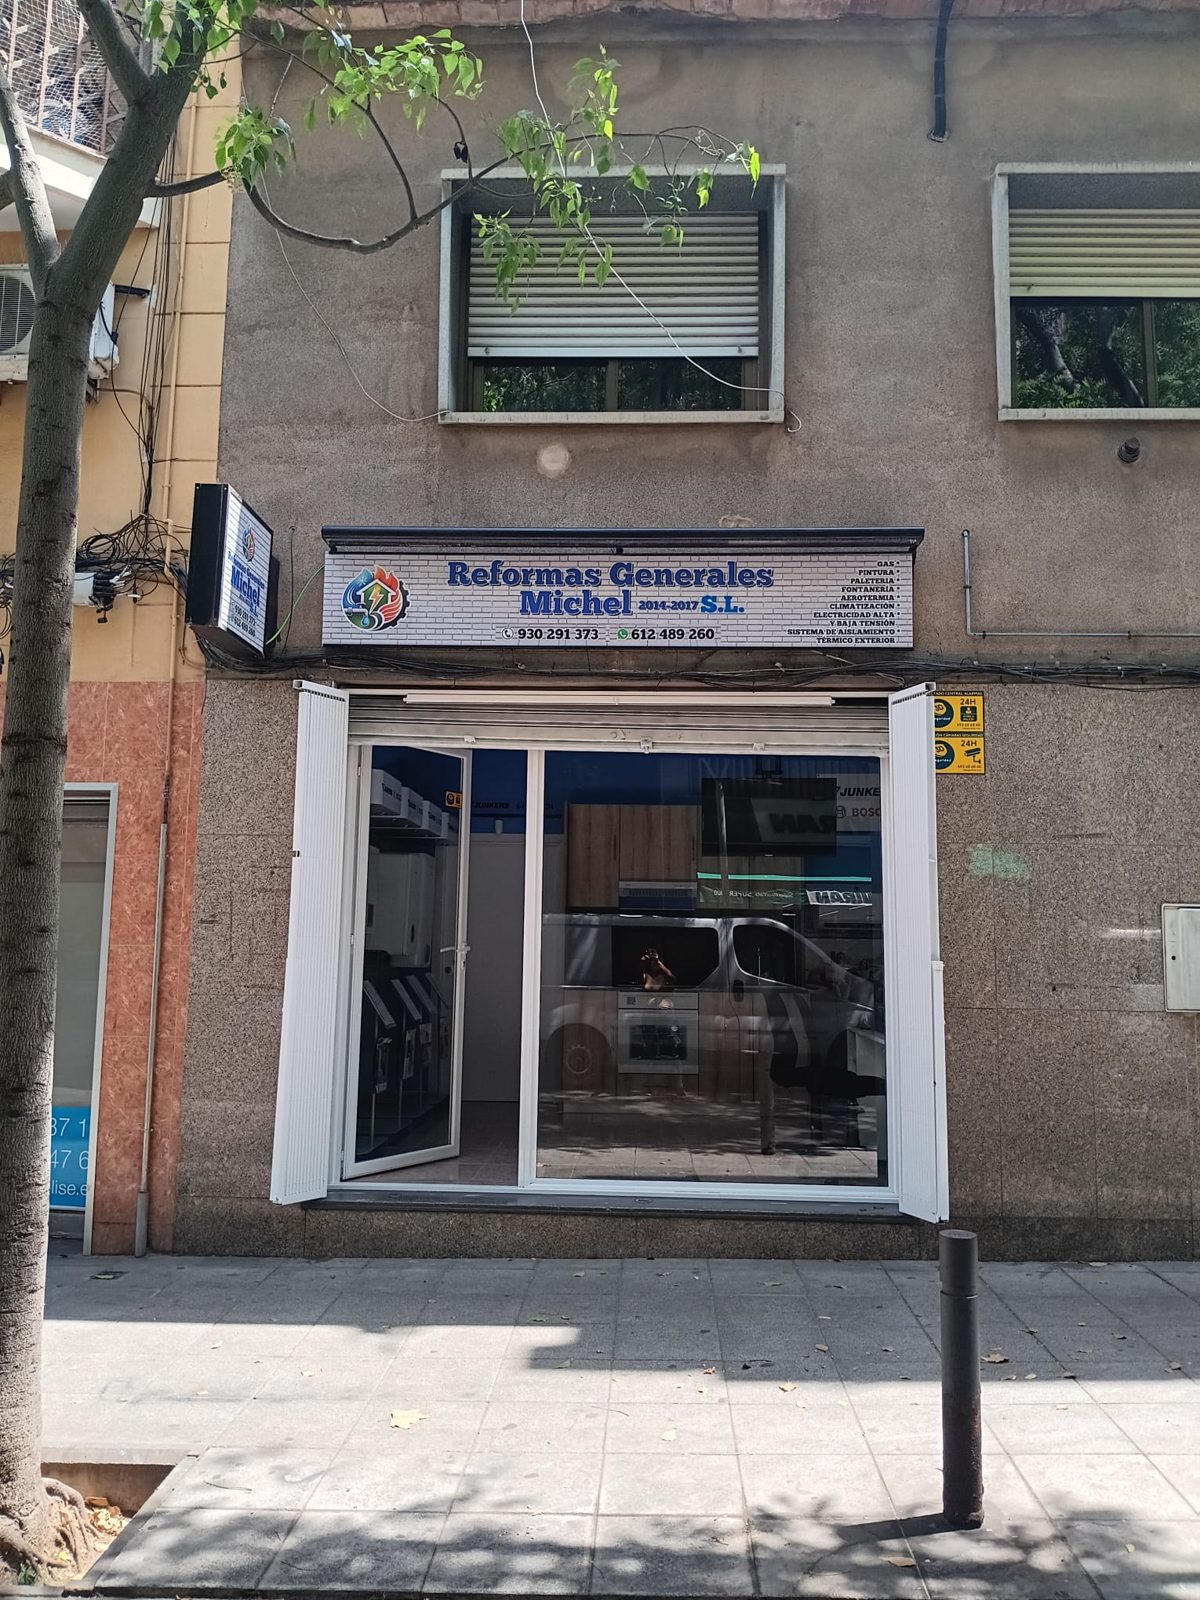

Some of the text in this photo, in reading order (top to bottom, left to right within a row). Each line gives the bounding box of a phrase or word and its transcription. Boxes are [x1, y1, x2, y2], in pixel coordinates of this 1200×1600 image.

[447, 559, 775, 588] Reformas Generales
[231, 564, 261, 607] Michel
[841, 585, 895, 593] FONTANERÍA
[519, 589, 746, 616] Michel 2014-2017 S.L.
[829, 602, 895, 610] CLIMATIZACIÓN
[860, 619, 895, 627] TENSIÓN
[517, 628, 599, 640] 930 291 373
[631, 628, 715, 640] 612 489 260
[961, 739, 977, 747] 24H
[840, 787, 880, 797] JUNKE
[852, 807, 880, 817] BOSC
[51, 1179, 88, 1196] lise.e
